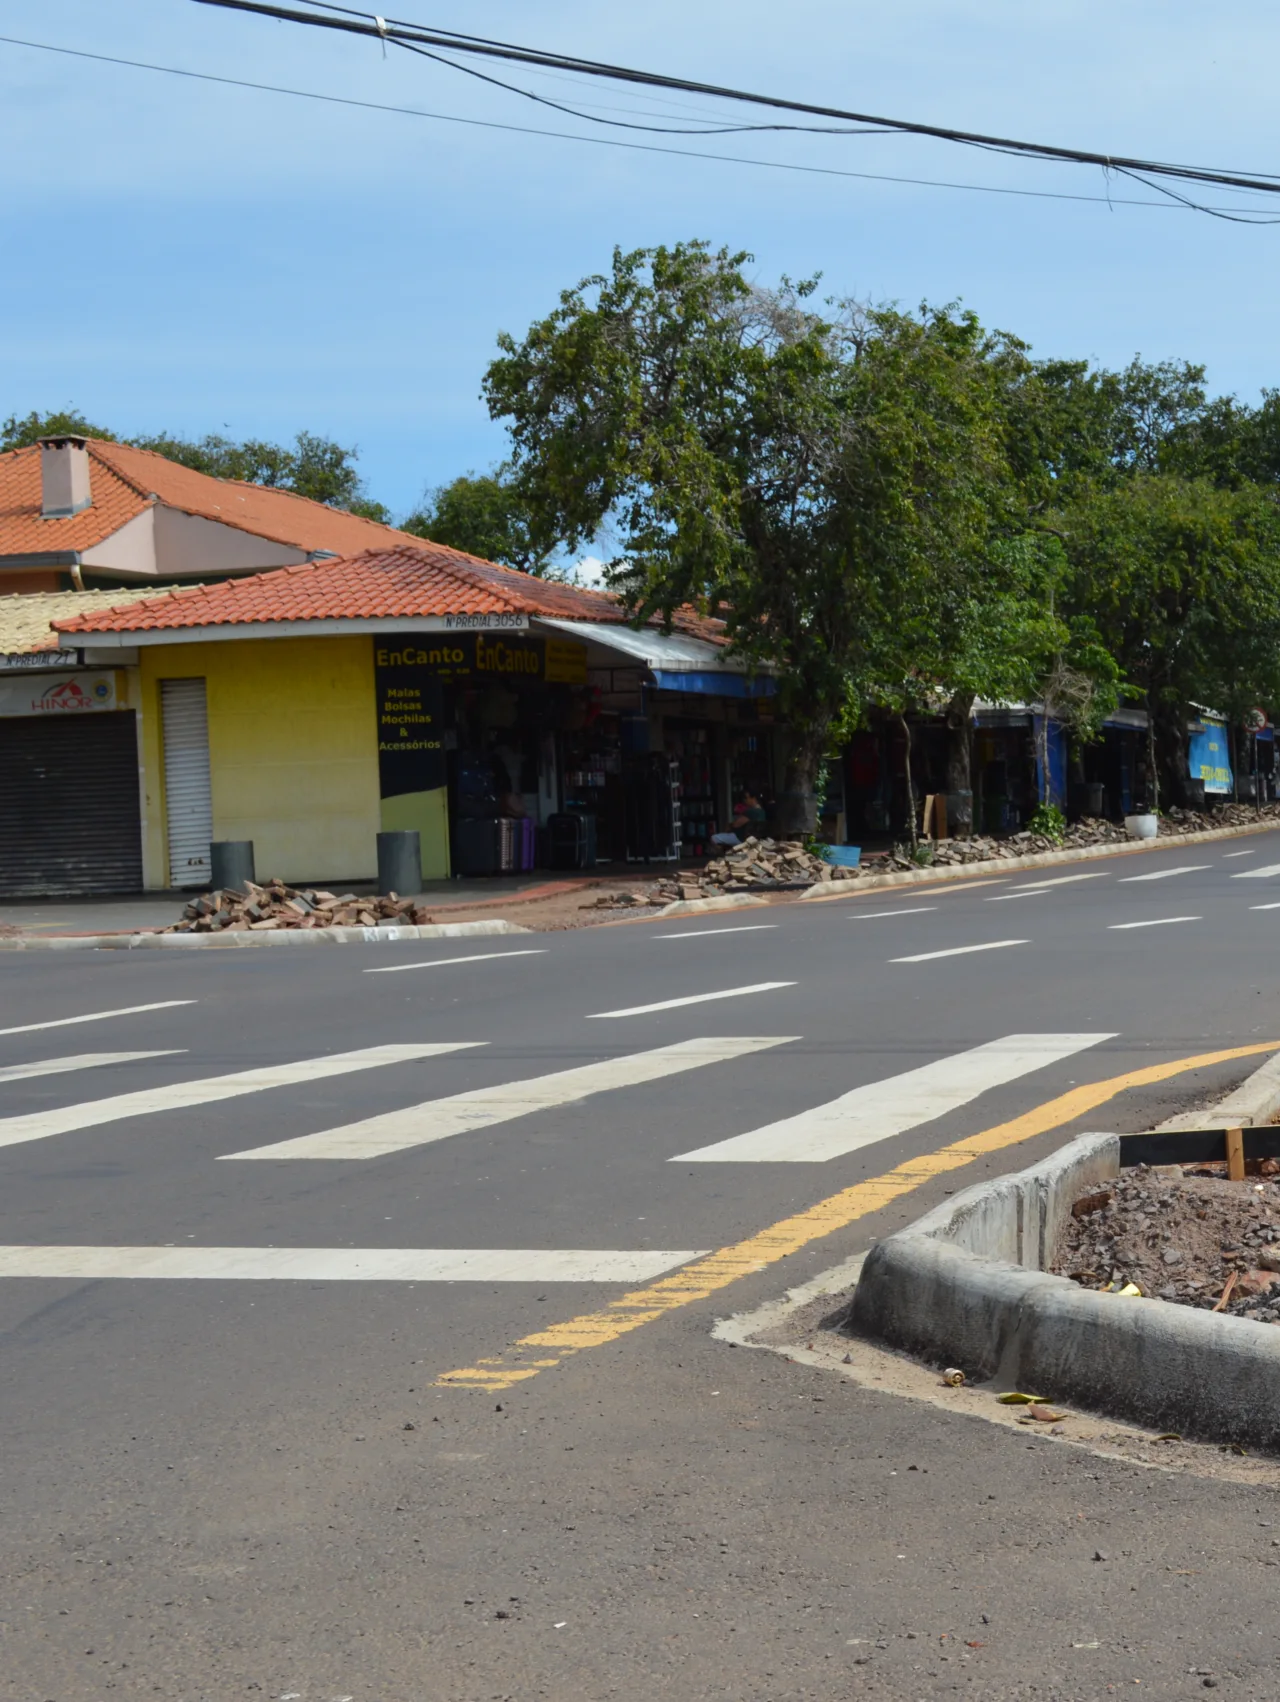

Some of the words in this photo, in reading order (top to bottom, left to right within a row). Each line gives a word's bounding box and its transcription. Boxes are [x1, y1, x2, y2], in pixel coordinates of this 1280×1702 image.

[456, 615, 491, 628] PREDIAL
[494, 613, 523, 627] 3056
[16, 653, 51, 666] PREDIAL
[377, 647, 464, 667] EnCanto
[476, 639, 539, 673] EnCanto
[387, 688, 421, 698] Malas
[31, 696, 93, 711] HINOR
[384, 701, 422, 711] Bolsas
[381, 714, 432, 724] Mochilas
[400, 728, 408, 737] &
[379, 739, 441, 750] Acessórios
